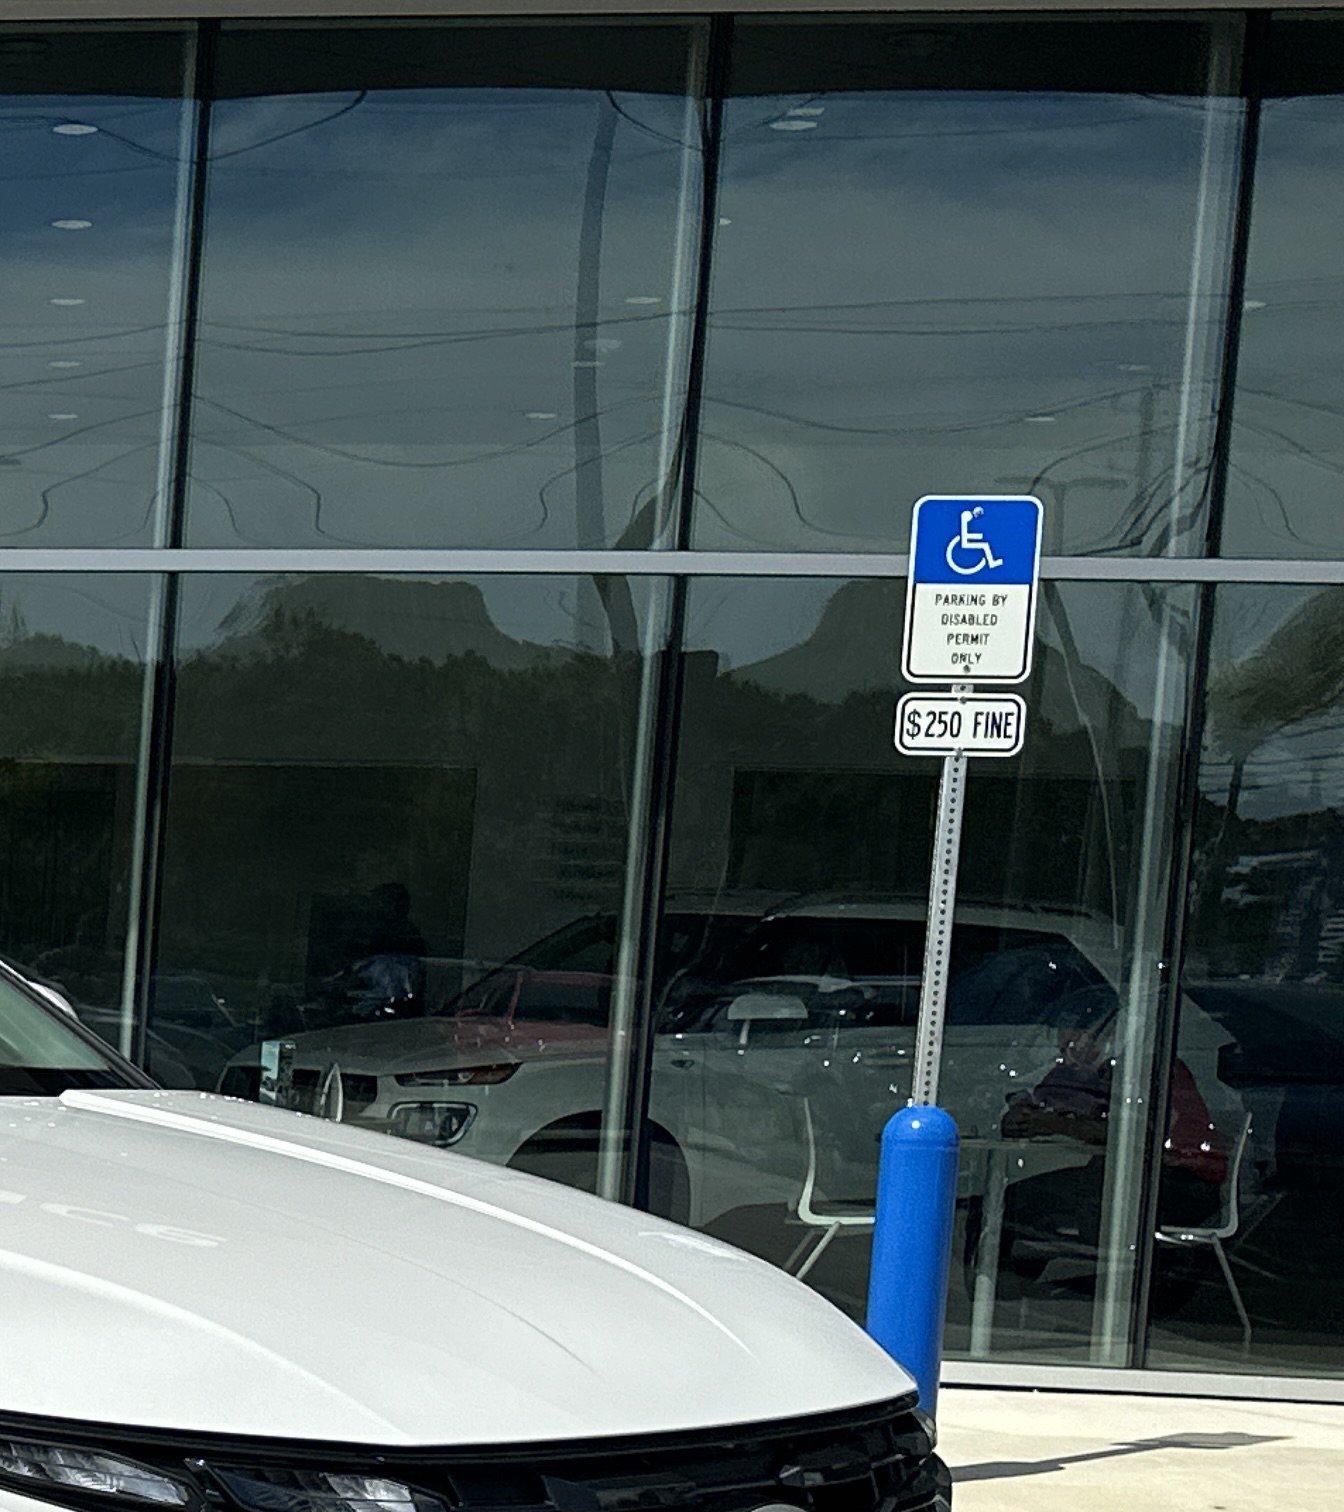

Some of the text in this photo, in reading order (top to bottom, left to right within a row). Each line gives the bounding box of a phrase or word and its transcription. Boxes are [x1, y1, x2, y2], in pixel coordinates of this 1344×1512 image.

[934, 593, 1009, 606] PARKING BY
[940, 613, 998, 626] DISABLED
[946, 633, 990, 646] PERMIT
[950, 652, 982, 665] ONLY
[905, 708, 1016, 740] $250 FINE
